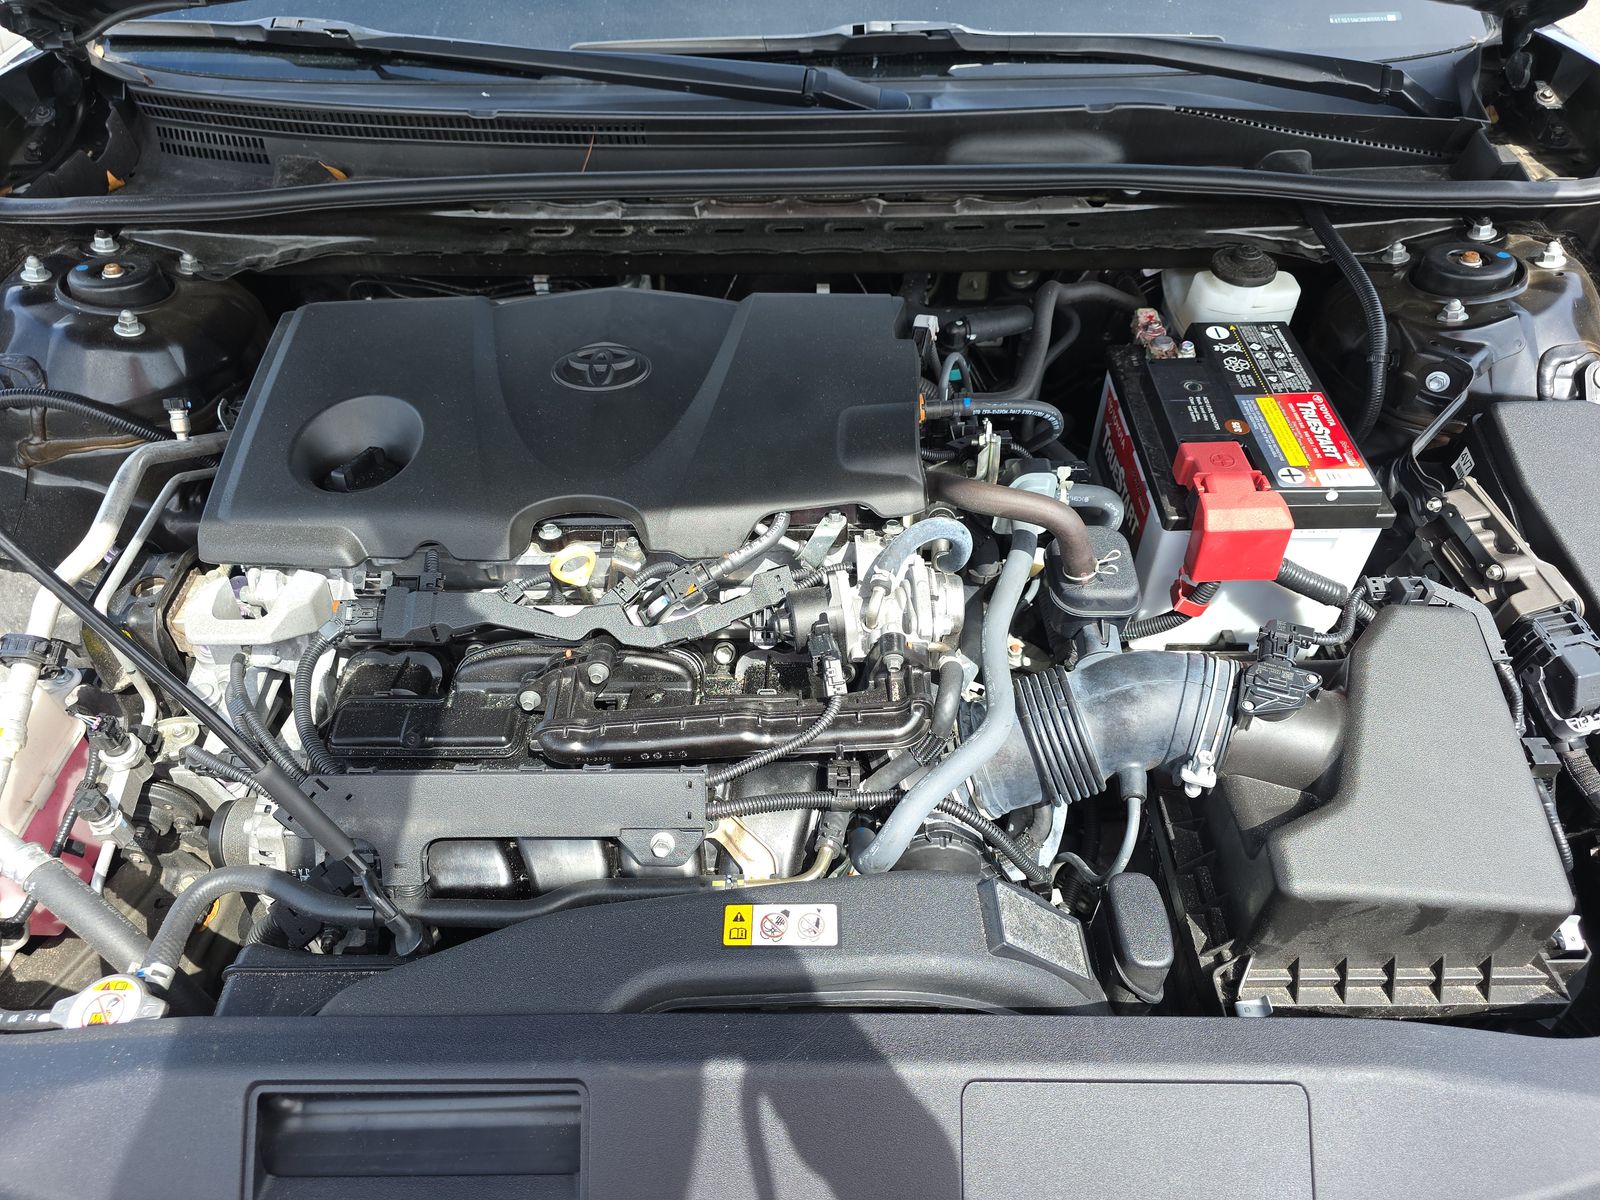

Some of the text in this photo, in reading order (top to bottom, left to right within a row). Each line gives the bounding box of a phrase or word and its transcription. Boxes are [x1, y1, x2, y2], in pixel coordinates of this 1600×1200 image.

[1318, 403, 1336, 427] TOYOTA
[1296, 400, 1343, 462] TRUESTART
[1460, 452, 1473, 471] 4V7
